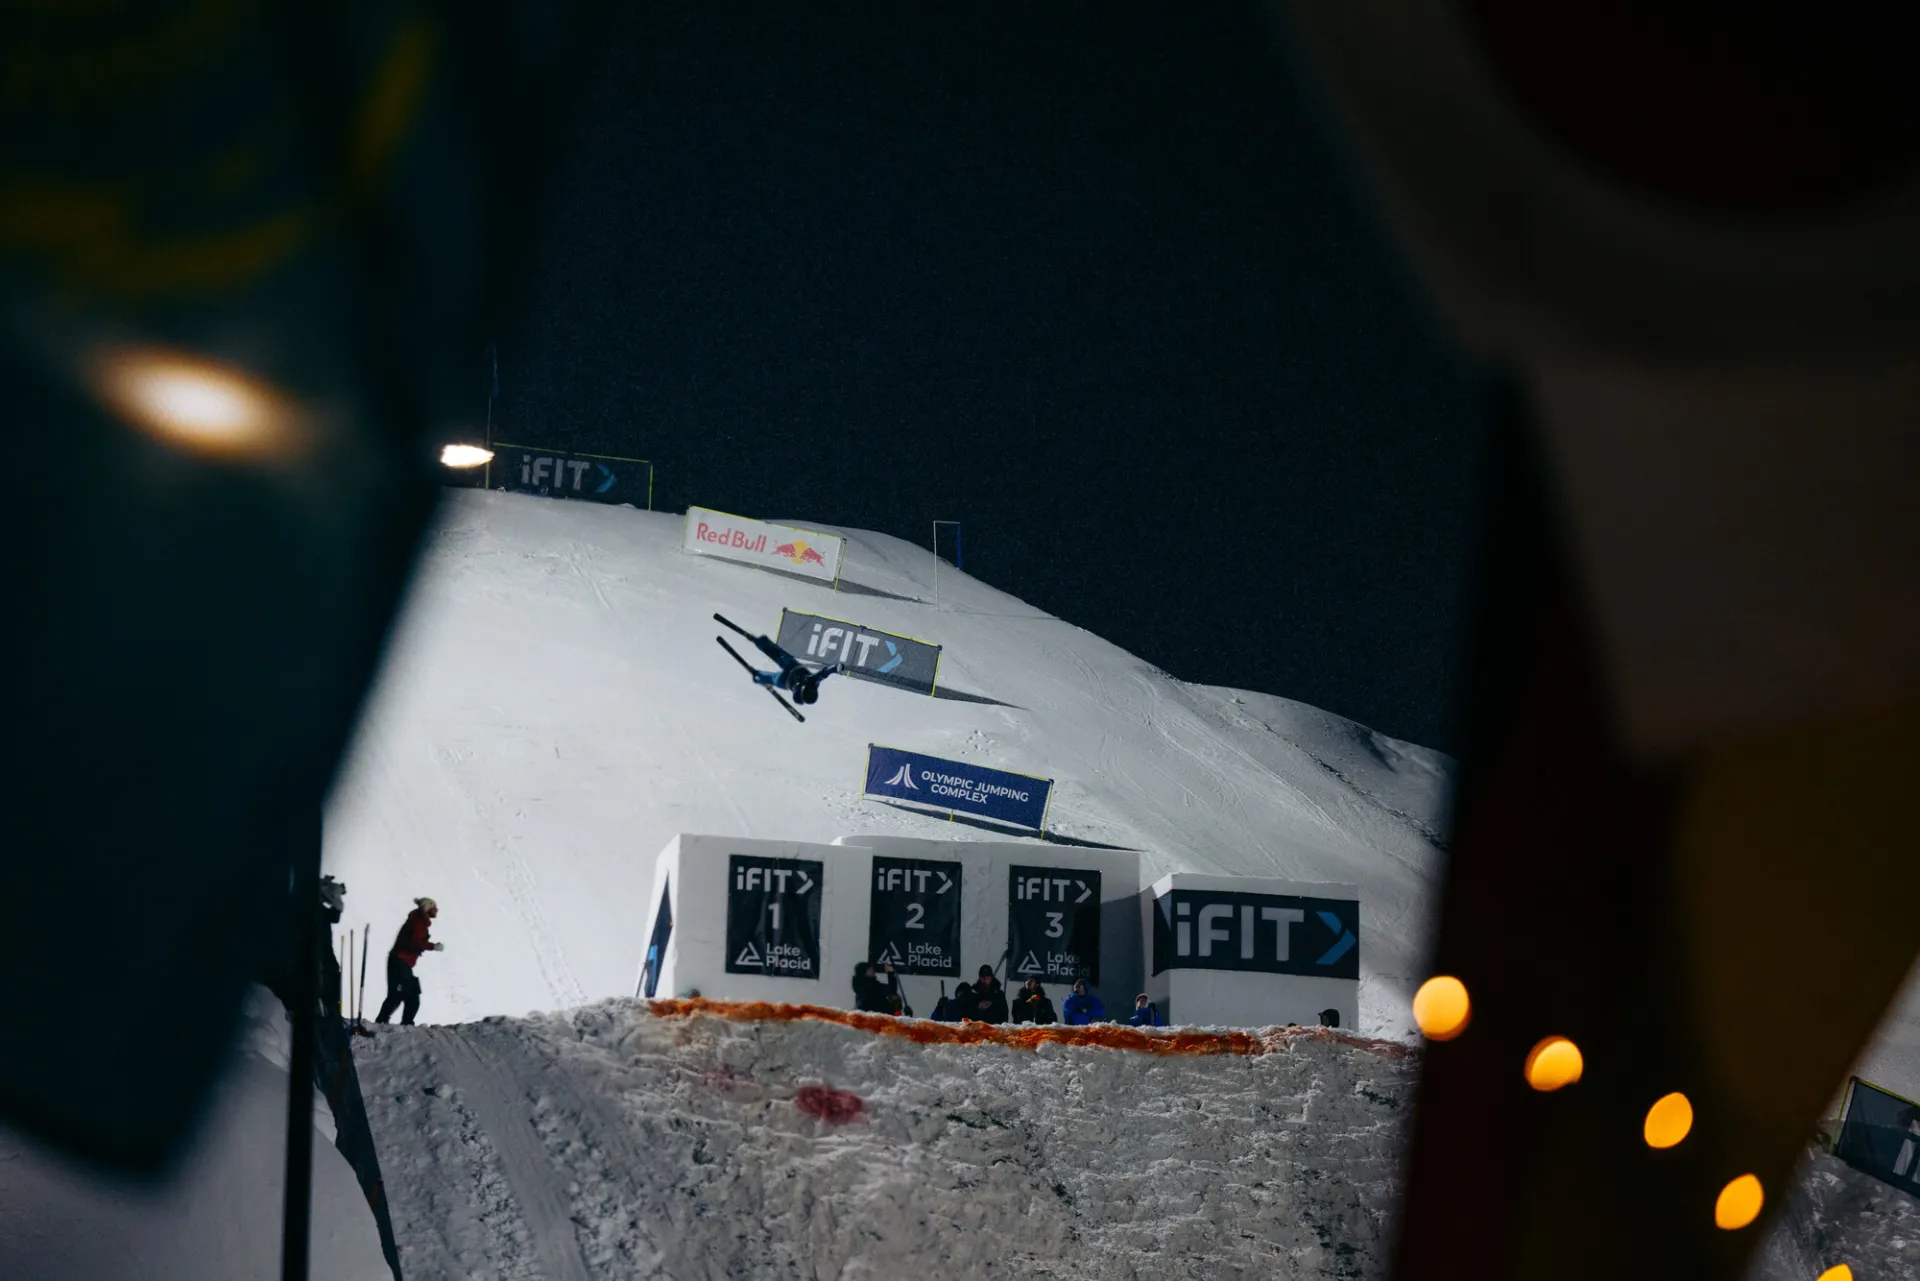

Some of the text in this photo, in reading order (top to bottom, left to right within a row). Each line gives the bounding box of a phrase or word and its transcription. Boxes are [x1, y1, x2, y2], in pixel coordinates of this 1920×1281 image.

[521, 454, 591, 491] iFIT
[696, 521, 768, 553] Red Bull
[806, 623, 880, 667] iFIT
[921, 770, 1030, 803] OLYMPIC JUMPING
[931, 783, 989, 804] COMPLEX
[736, 866, 793, 894] iFIT
[878, 867, 932, 894] iFIT
[1017, 876, 1071, 902] iFIT
[768, 903, 780, 929] 1
[905, 903, 925, 930] 2
[1044, 911, 1064, 938] 3
[1176, 902, 1305, 962] iFIT
[766, 942, 801, 957] Lake
[907, 955, 952, 969] Placid
[908, 942, 942, 956] Lake
[1047, 950, 1081, 963] Lake
[765, 956, 811, 971] Placid
[1047, 963, 1091, 977] Placid
